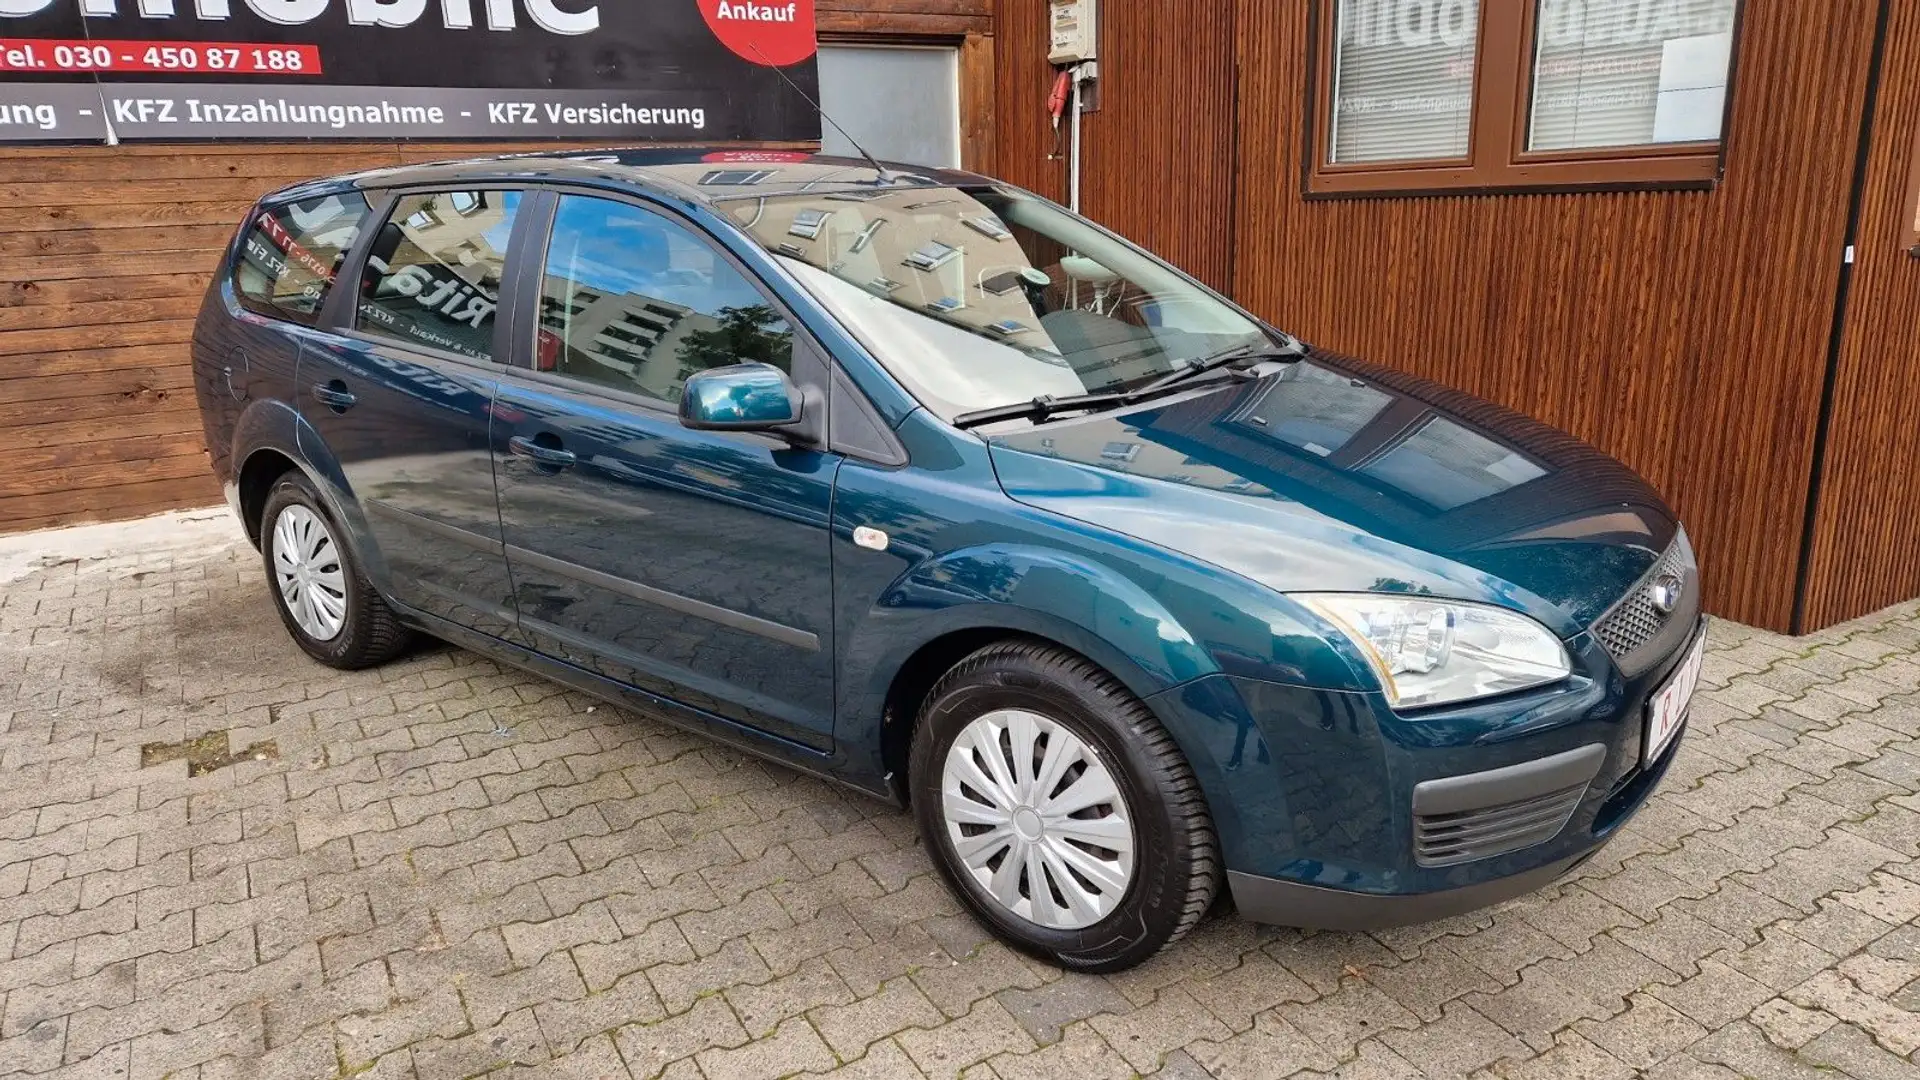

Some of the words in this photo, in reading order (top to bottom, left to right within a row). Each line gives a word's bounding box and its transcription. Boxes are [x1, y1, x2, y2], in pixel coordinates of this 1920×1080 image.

[717, 0, 796, 22] Ankauf
[54, 45, 111, 68] 030
[143, 47, 197, 69] 450
[206, 48, 240, 69] 87
[251, 49, 303, 70] 188
[113, 98, 178, 123] KFZ
[186, 98, 444, 129] Inzahlungnahme
[488, 102, 538, 124] KFZ
[544, 102, 705, 129] Versicherung
